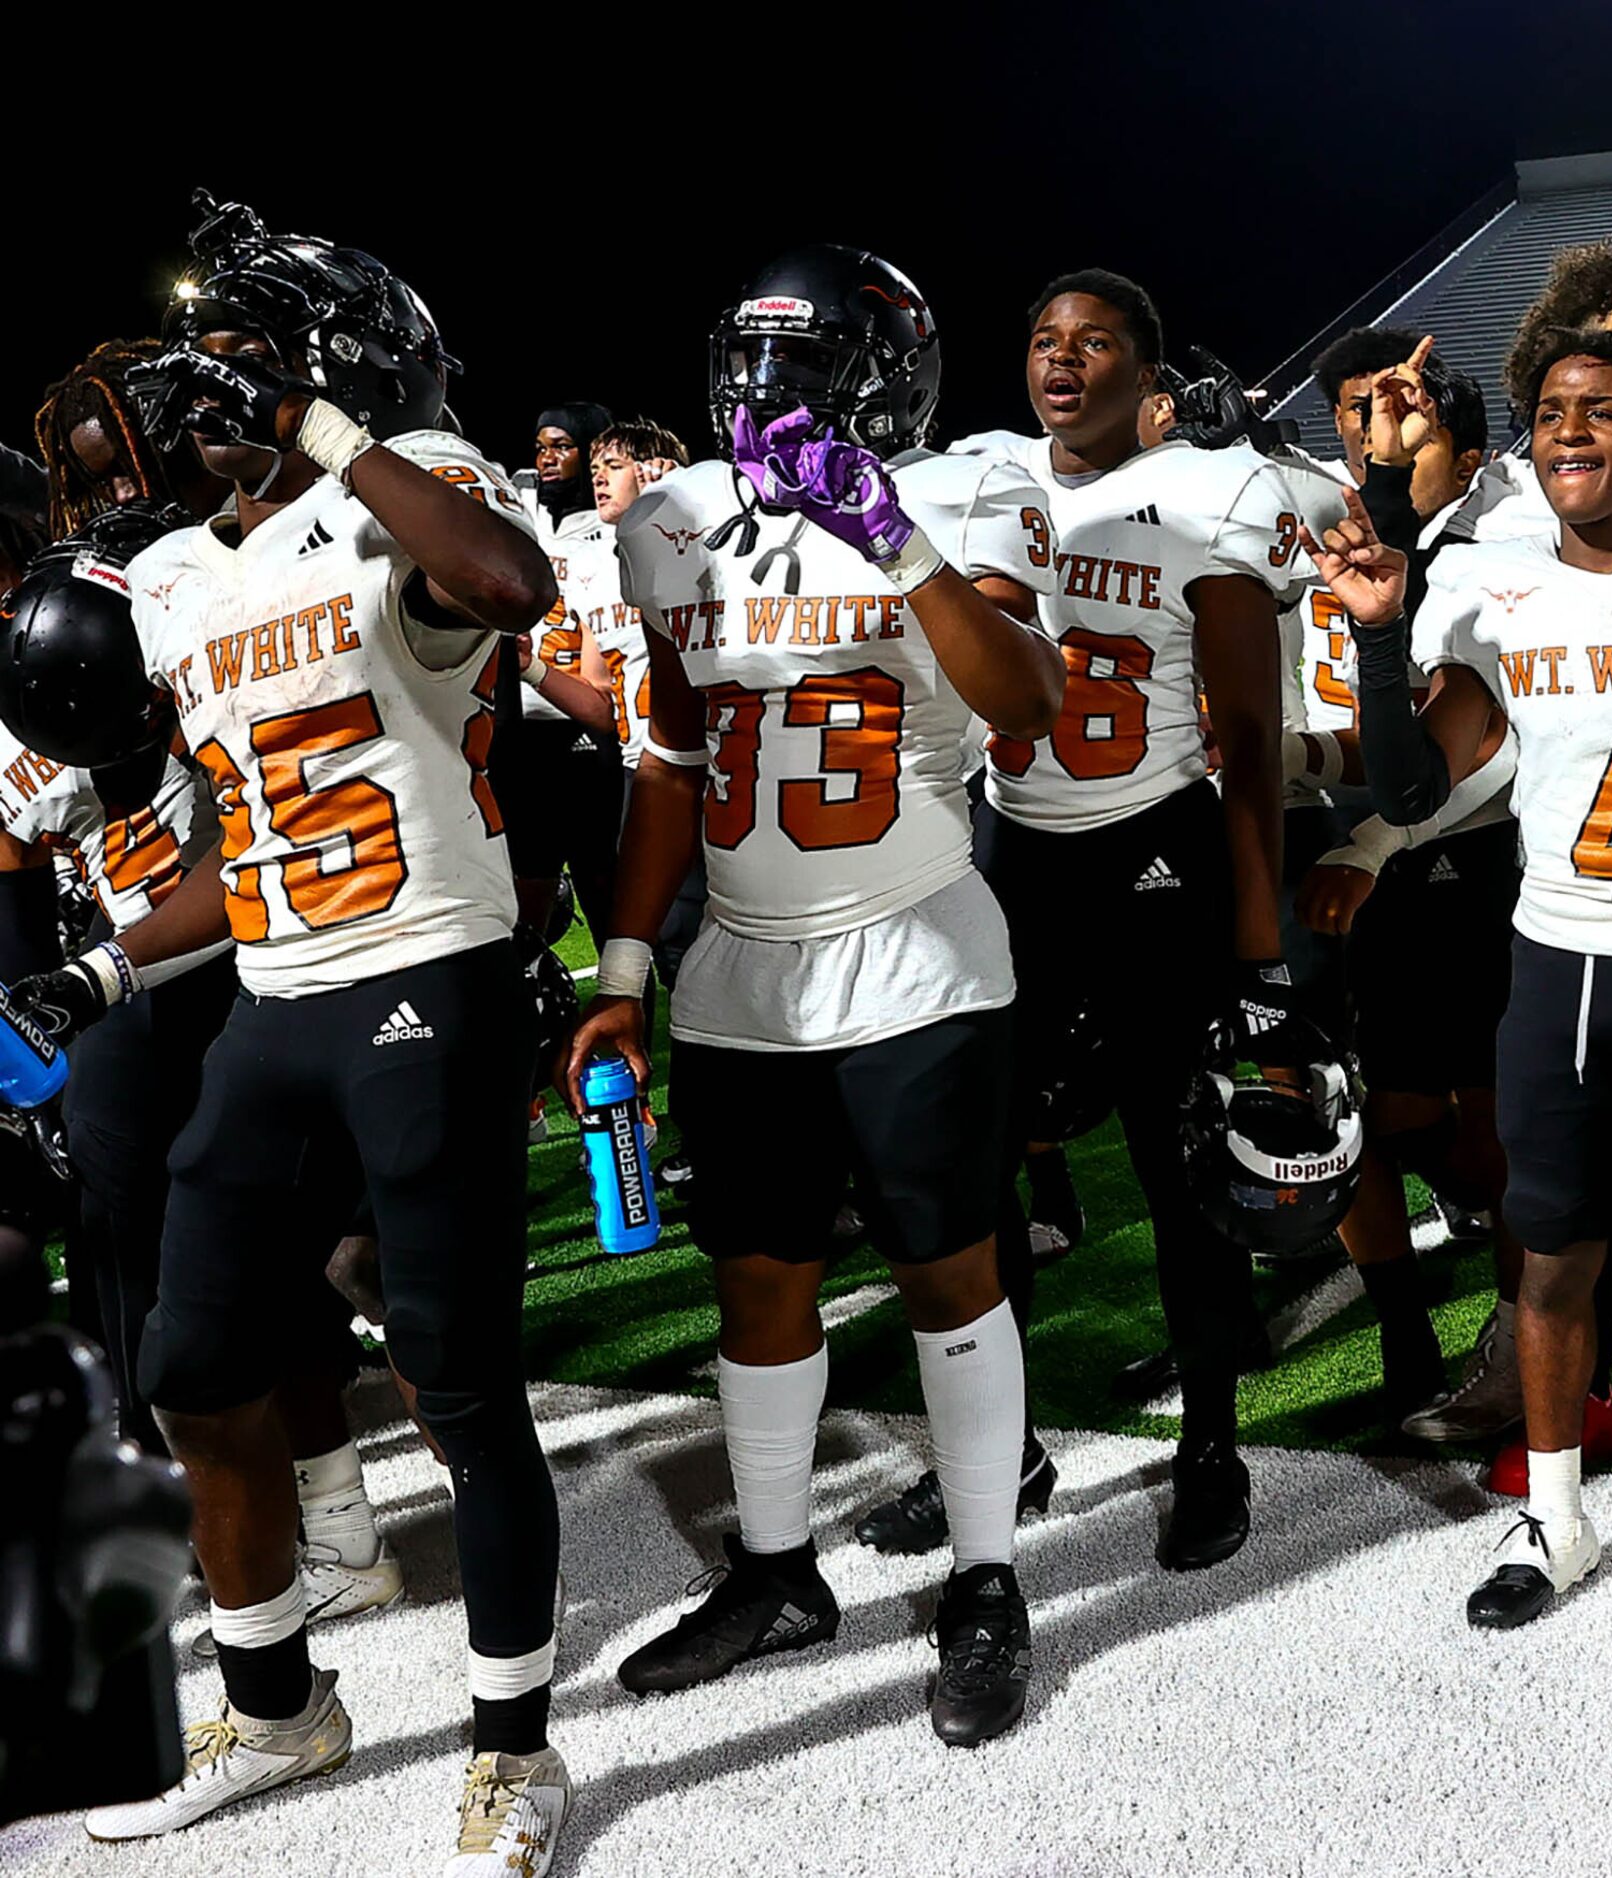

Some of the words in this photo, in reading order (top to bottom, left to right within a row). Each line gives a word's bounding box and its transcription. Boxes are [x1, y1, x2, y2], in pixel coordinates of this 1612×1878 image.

[756, 300, 797, 312] Riddell
[744, 595, 905, 646] WHITE
[205, 592, 362, 694] WHITE
[1499, 646, 1574, 698] W.T.
[1134, 876, 1182, 891] adidas
[1239, 999, 1287, 1020] adidas
[372, 1026, 434, 1046] adidas
[611, 1102, 646, 1225] POWERADE
[1275, 1152, 1348, 1180] Riddell
